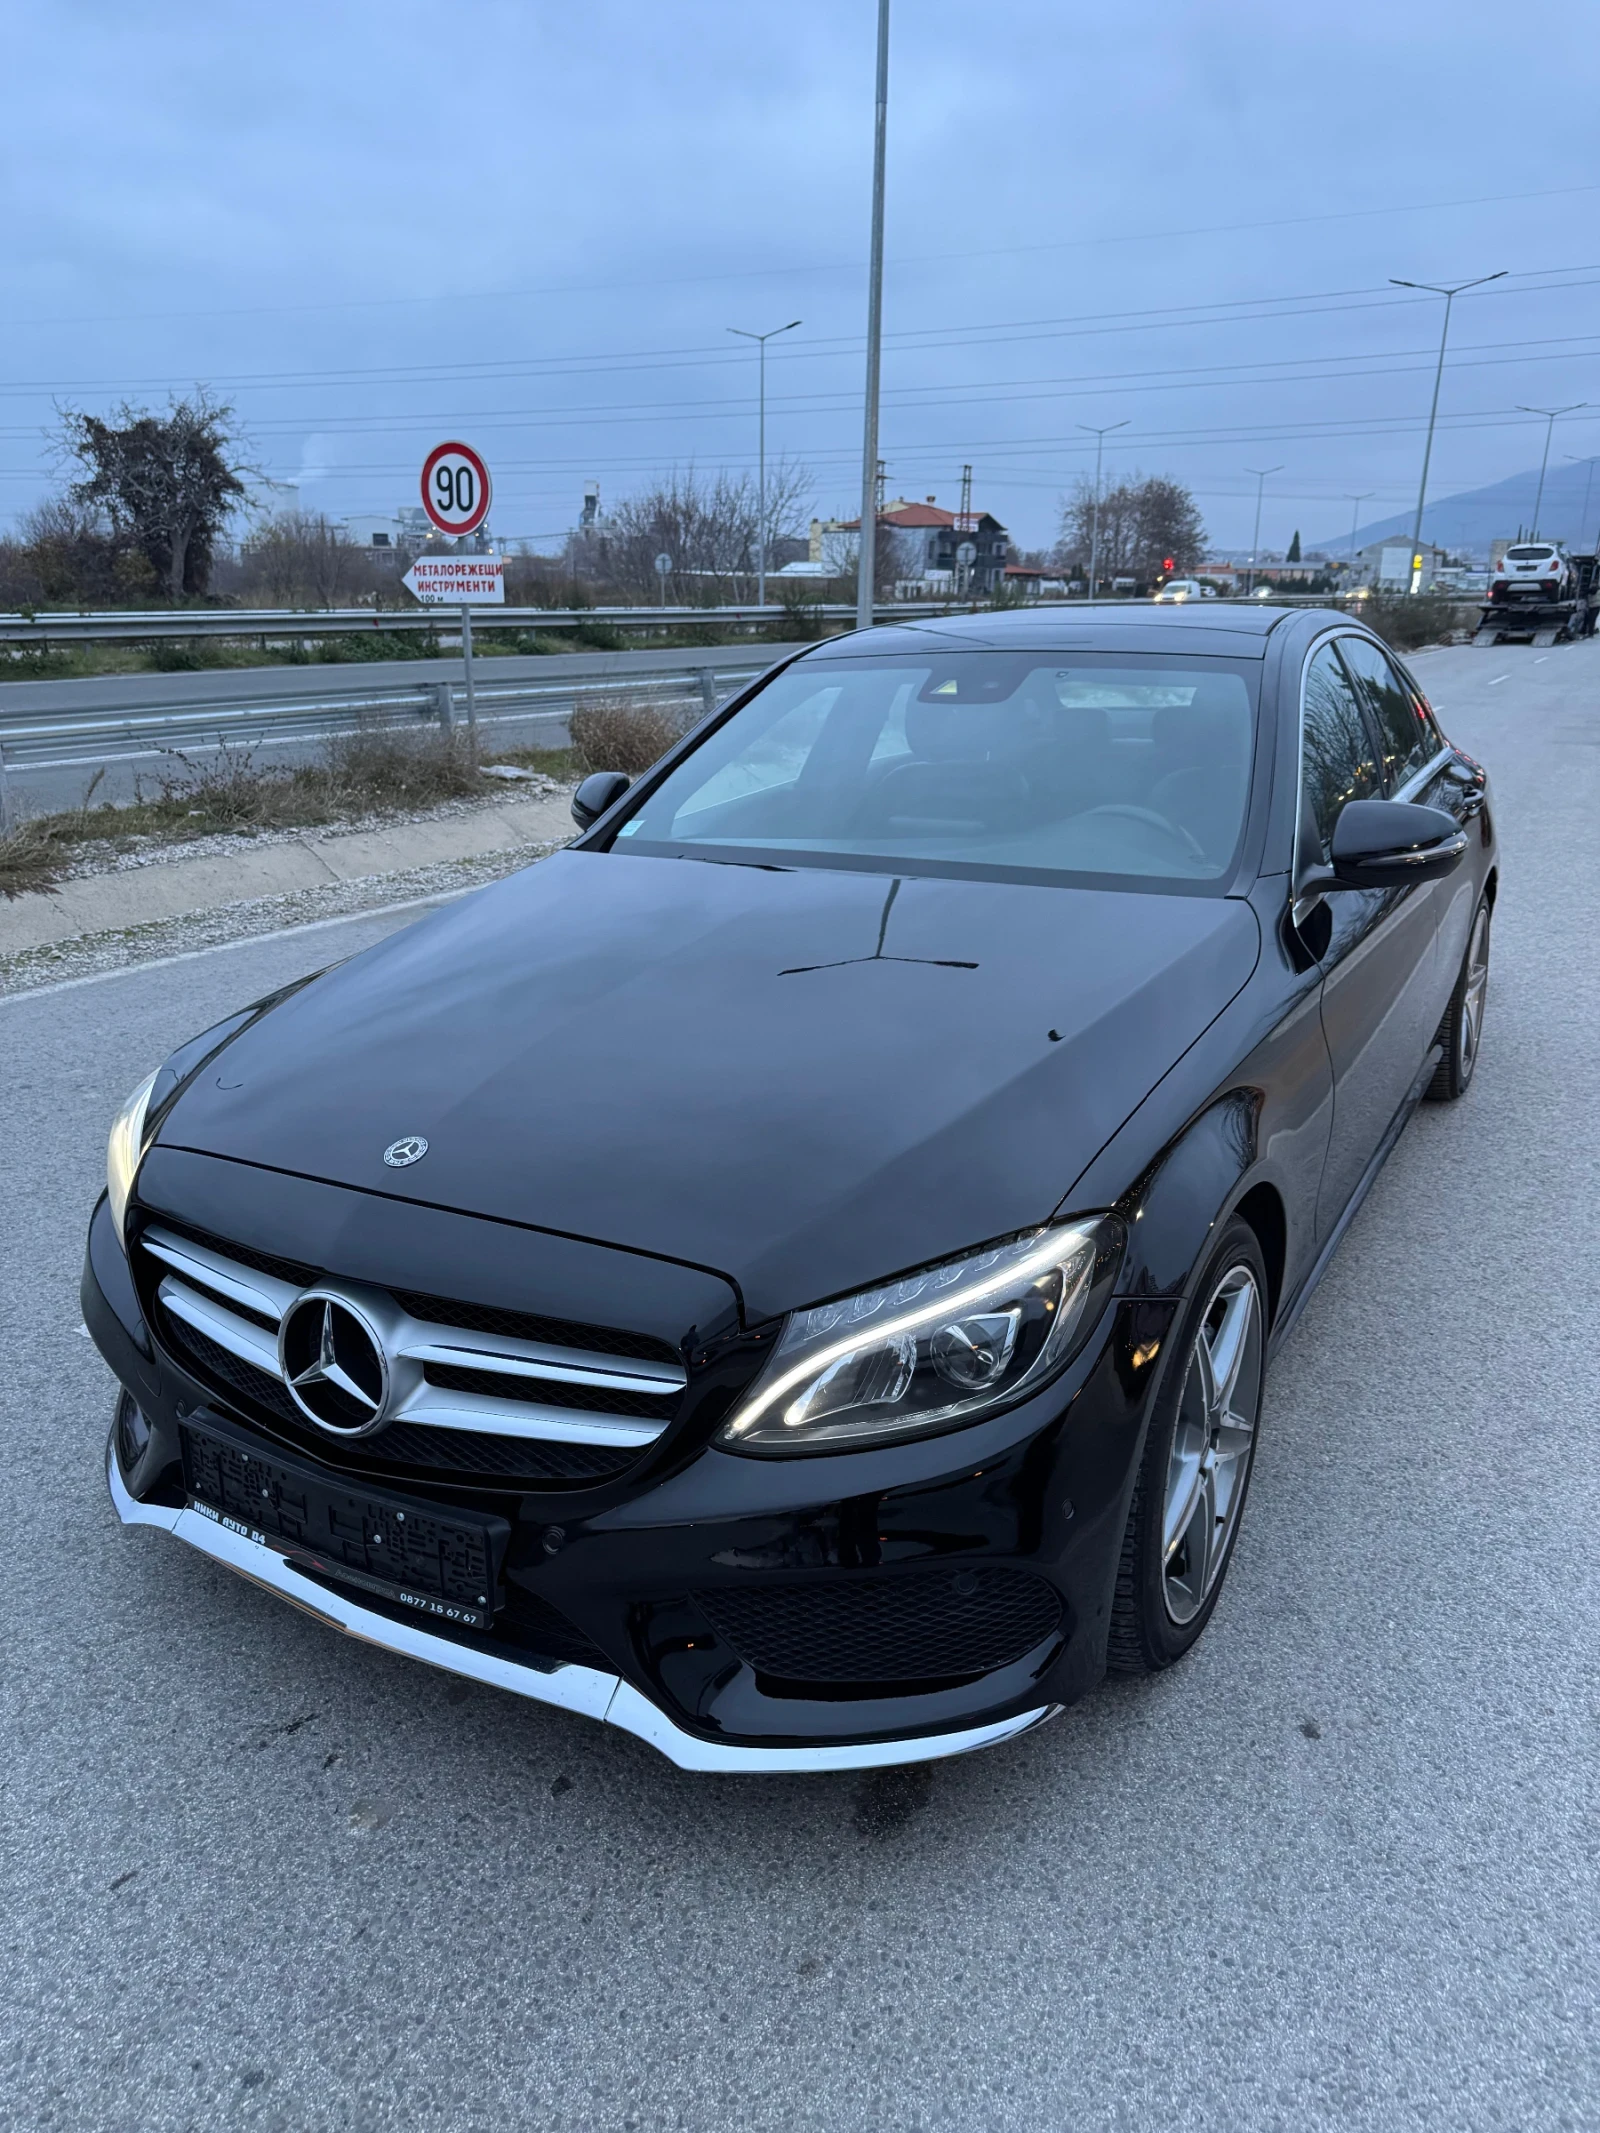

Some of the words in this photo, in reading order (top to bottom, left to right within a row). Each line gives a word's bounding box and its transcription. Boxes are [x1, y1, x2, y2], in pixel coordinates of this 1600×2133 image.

[436, 465, 473, 512] 90
[413, 564, 503, 577] МЕТАЛОРЕЖЕЩИ
[417, 580, 495, 592] ИНСТРУМЕНТИ
[420, 594, 435, 603] 100
[400, 1593, 427, 1608] 0877
[429, 1602, 444, 1614] 15
[446, 1608, 460, 1618] 67
[463, 1613, 477, 1624] 67
